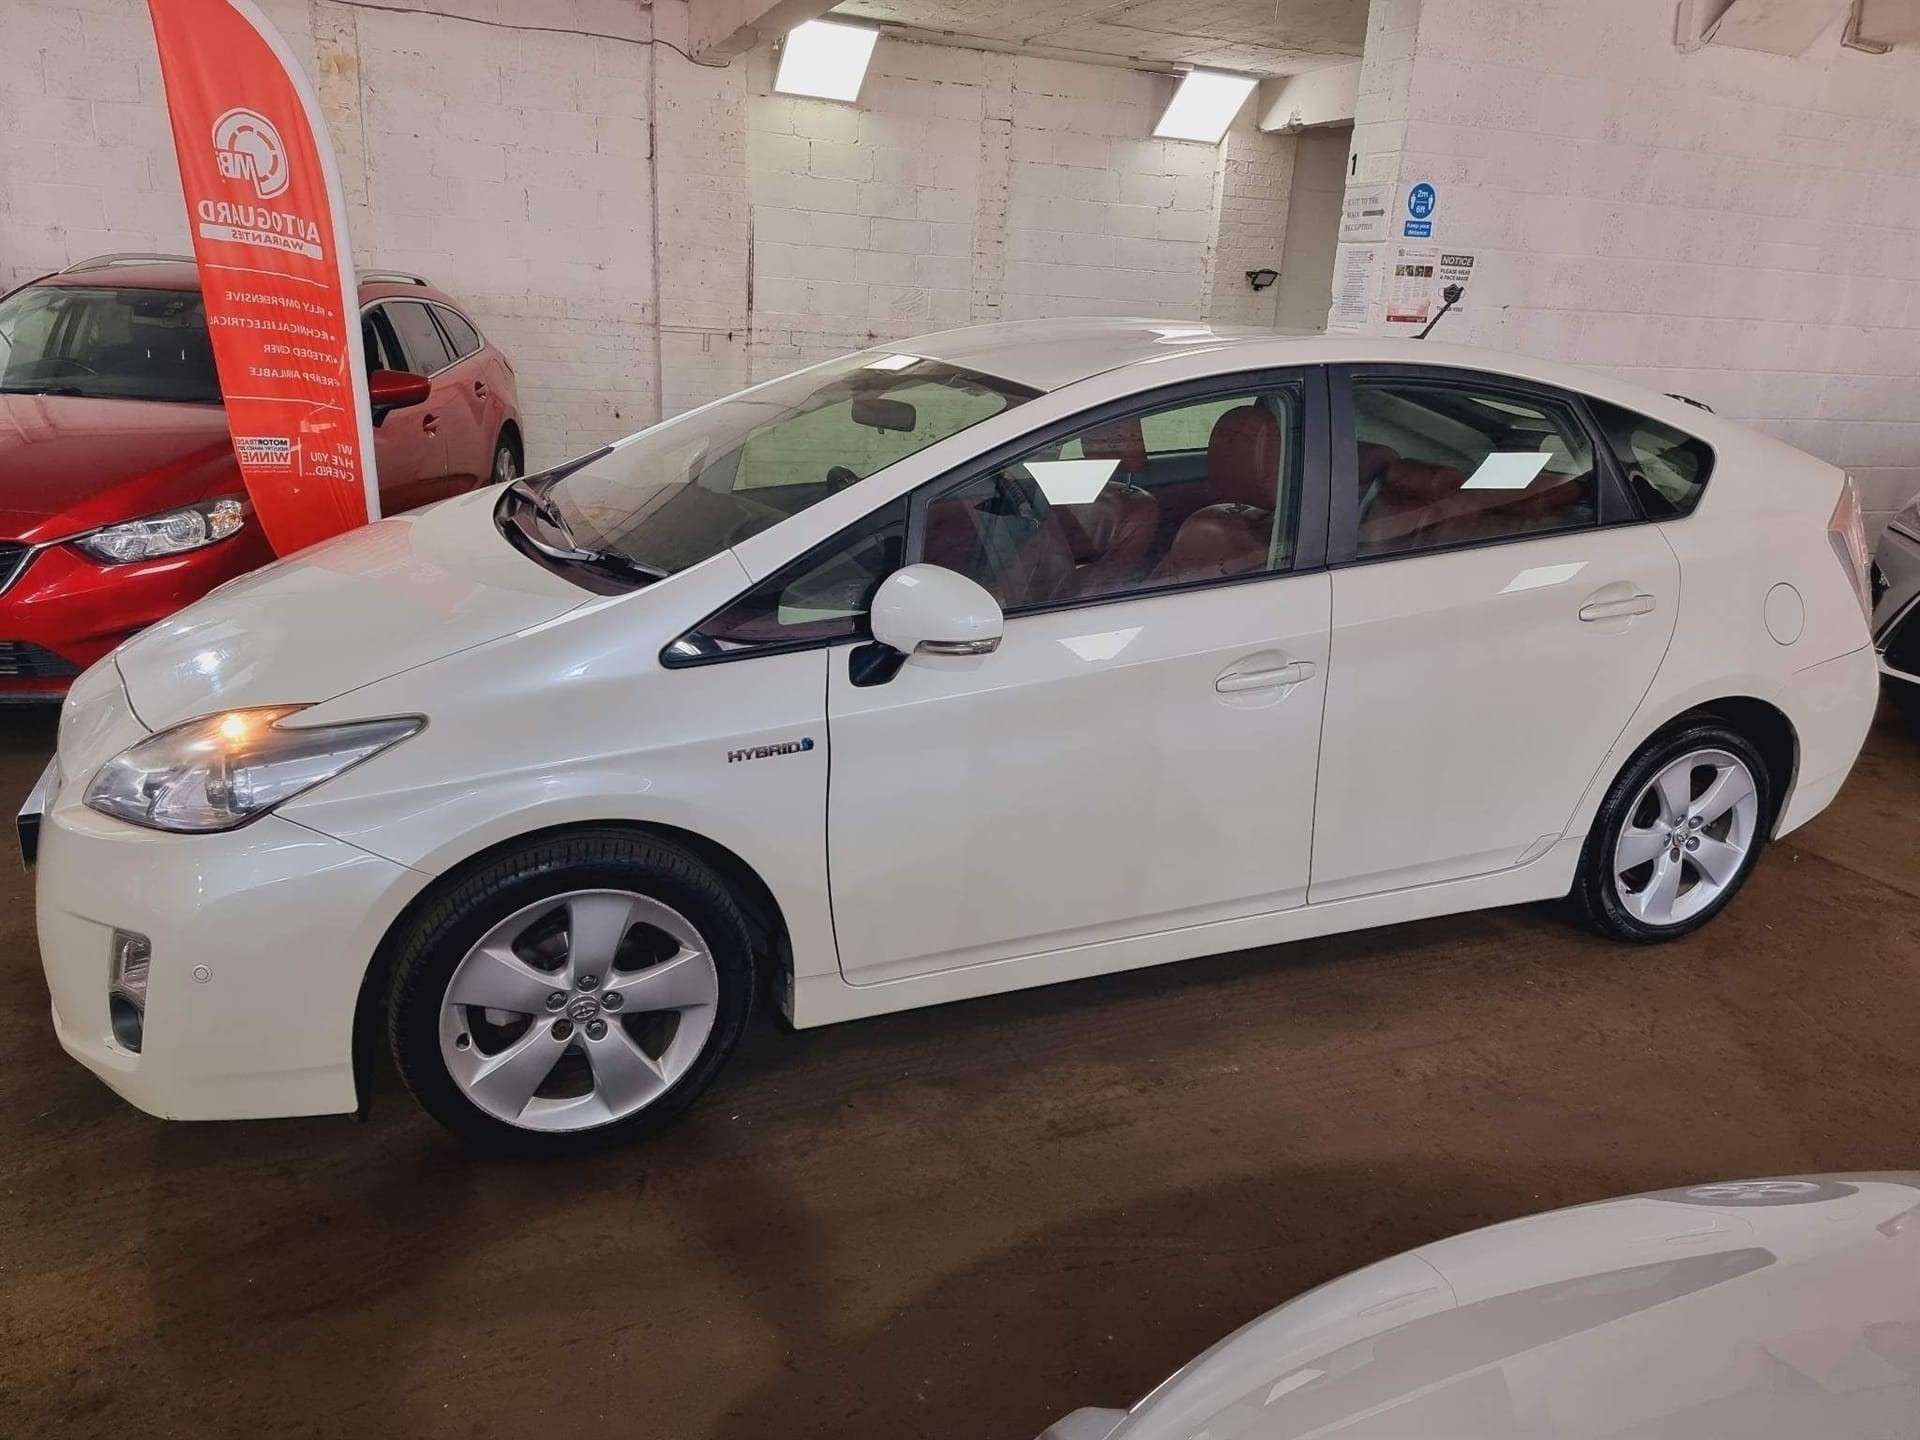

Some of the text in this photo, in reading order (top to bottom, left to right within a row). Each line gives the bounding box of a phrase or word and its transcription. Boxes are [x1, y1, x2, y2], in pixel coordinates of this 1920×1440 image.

[1351, 153, 1358, 176] 1
[1416, 189, 1429, 198] 2m
[1441, 256, 1473, 266] NOTICE
[727, 741, 801, 763] HYBRID
